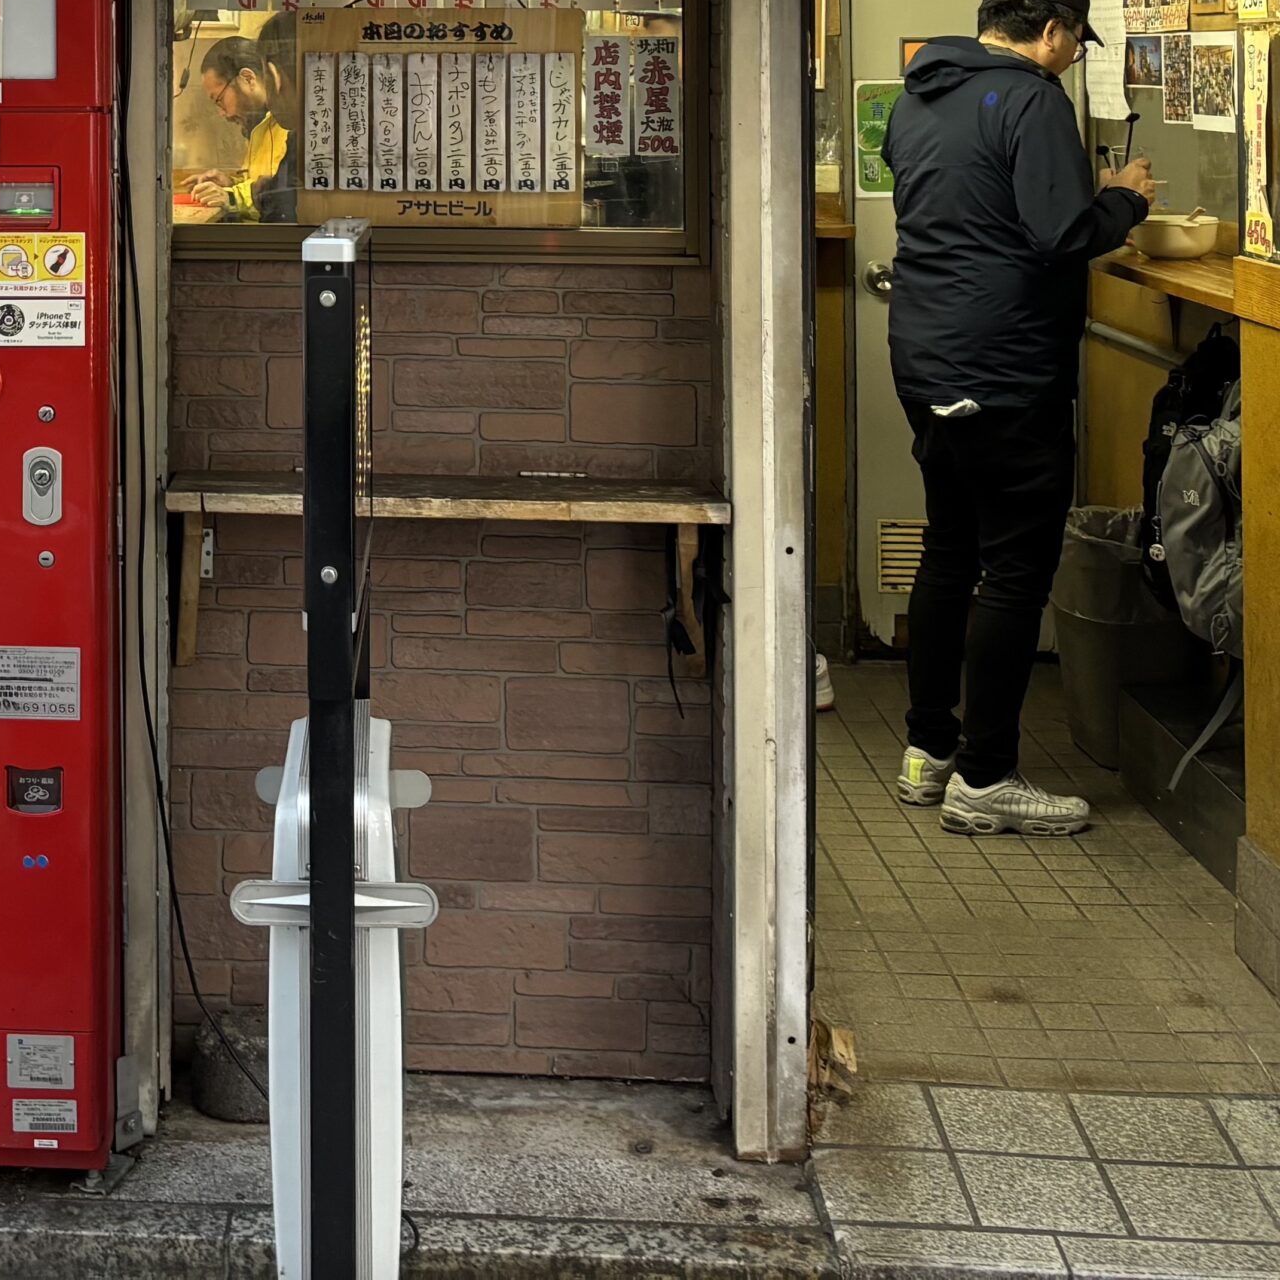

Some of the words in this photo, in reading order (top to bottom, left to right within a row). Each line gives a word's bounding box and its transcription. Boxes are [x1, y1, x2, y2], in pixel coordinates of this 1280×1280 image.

[637, 39, 675, 55] サッポロ
[592, 40, 624, 145] 店内禁煙
[639, 56, 675, 115] 赤星
[641, 116, 674, 133] 大瓶
[396, 200, 493, 217] アサヒビール
[37, 312, 71, 320] iPhoneで
[29, 321, 81, 329] タッチレス体験!
